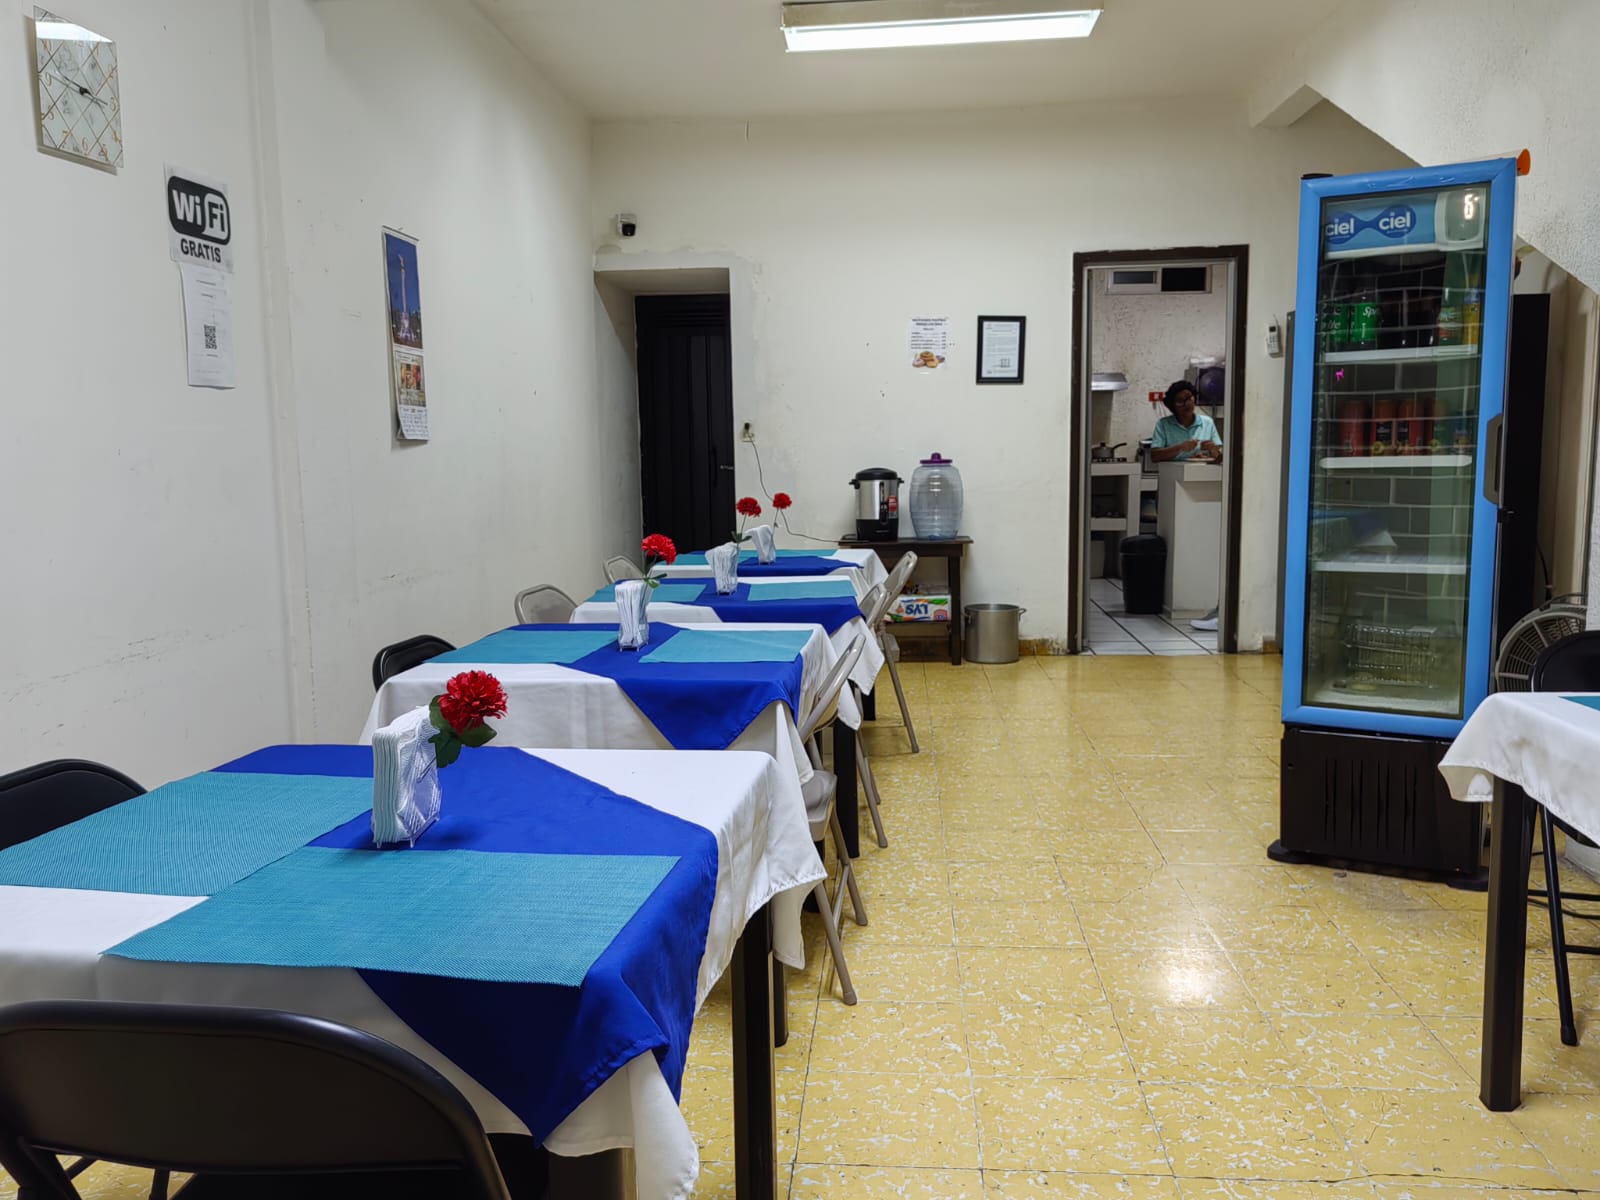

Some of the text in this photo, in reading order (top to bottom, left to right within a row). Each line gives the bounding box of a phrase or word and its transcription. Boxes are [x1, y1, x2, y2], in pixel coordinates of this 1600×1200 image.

[110, 96, 118, 111] 3
[81, 137, 89, 155] 6
[1325, 218, 1355, 236] ciel
[1379, 210, 1411, 230] ciel
[181, 238, 222, 263] GRATIS
